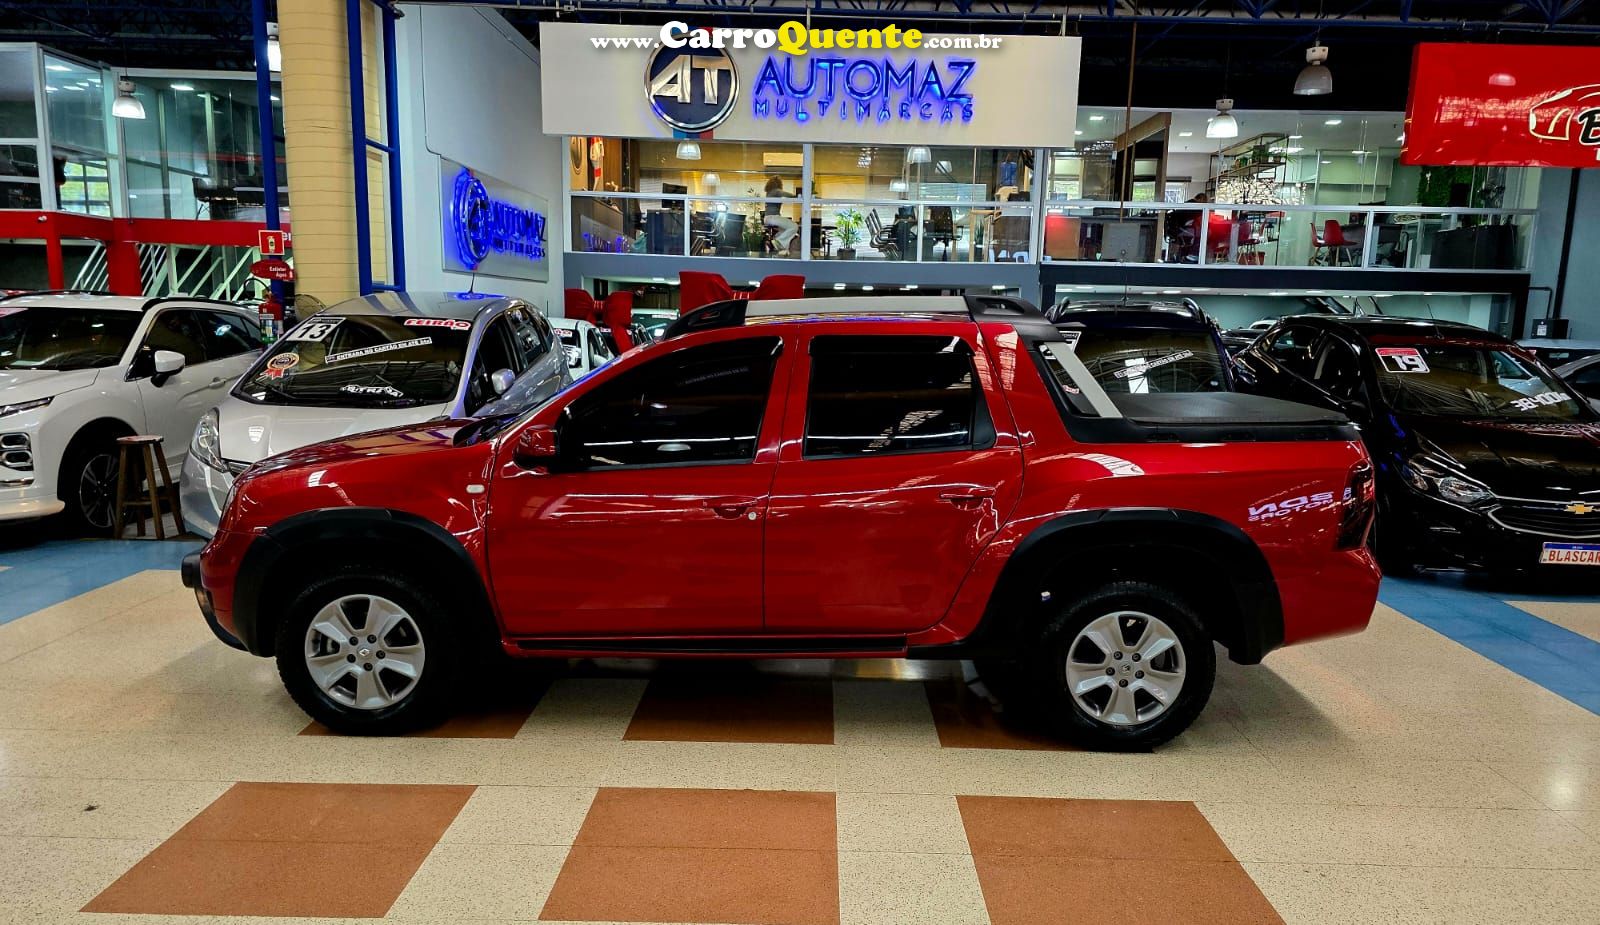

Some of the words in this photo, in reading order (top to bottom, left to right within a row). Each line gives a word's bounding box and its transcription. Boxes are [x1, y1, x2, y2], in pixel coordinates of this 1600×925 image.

[755, 56, 976, 99] AUTOMAZ
[755, 99, 974, 121] MULTIMARCAS
[298, 324, 331, 339] 13
[404, 319, 471, 330] FEIRÃO
[1392, 356, 1426, 371] 19
